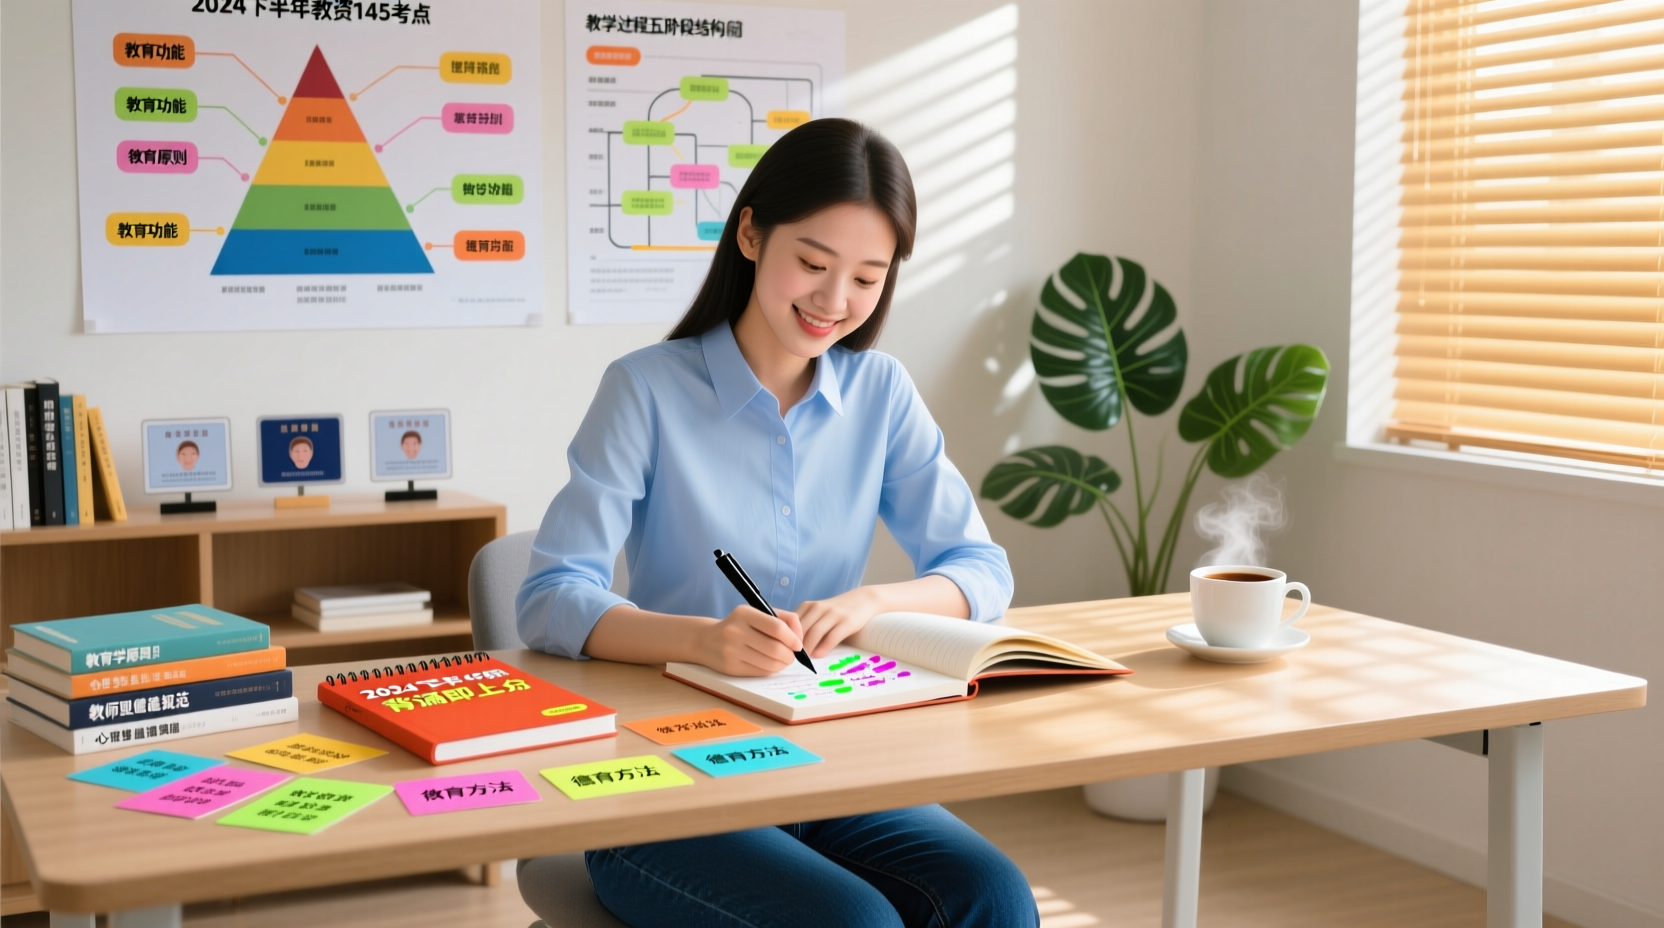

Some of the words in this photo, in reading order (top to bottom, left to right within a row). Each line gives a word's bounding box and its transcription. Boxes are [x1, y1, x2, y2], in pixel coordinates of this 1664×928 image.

[124, 41, 186, 61] 教育功能
[126, 95, 187, 114] 教育功能
[117, 222, 179, 239] 教育功能
